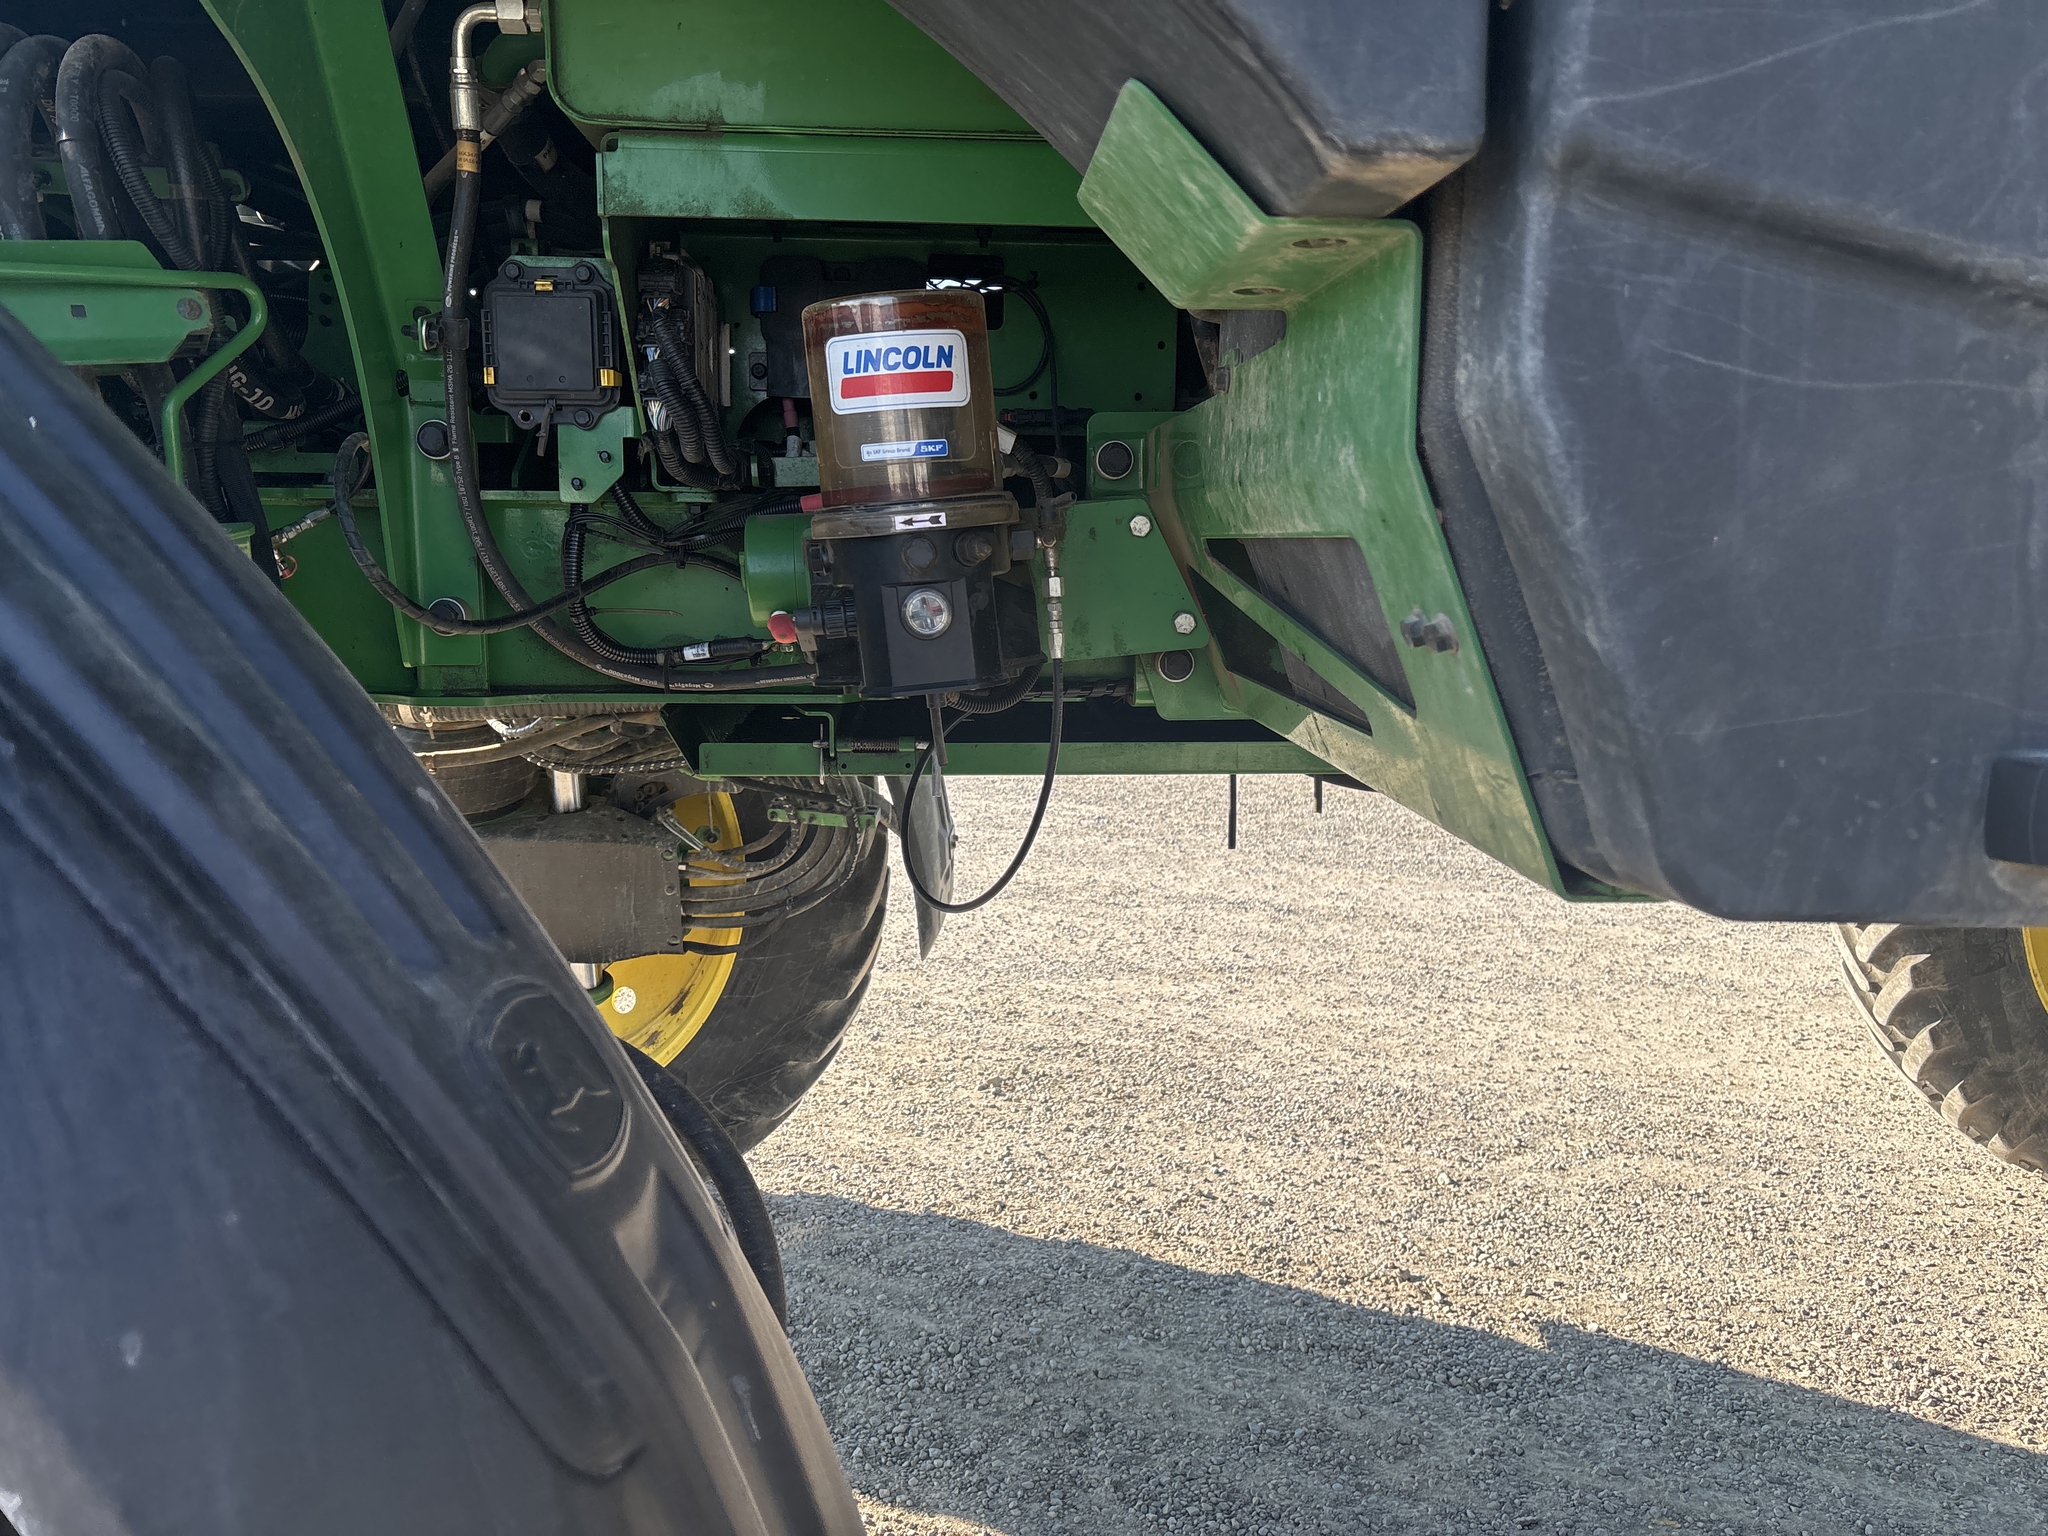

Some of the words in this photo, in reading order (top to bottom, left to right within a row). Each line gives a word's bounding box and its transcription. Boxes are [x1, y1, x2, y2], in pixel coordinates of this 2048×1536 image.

[78, 163, 106, 235] ALFAGOMMA
[843, 345, 954, 374] LINCOLN
[920, 444, 944, 453] SKF
